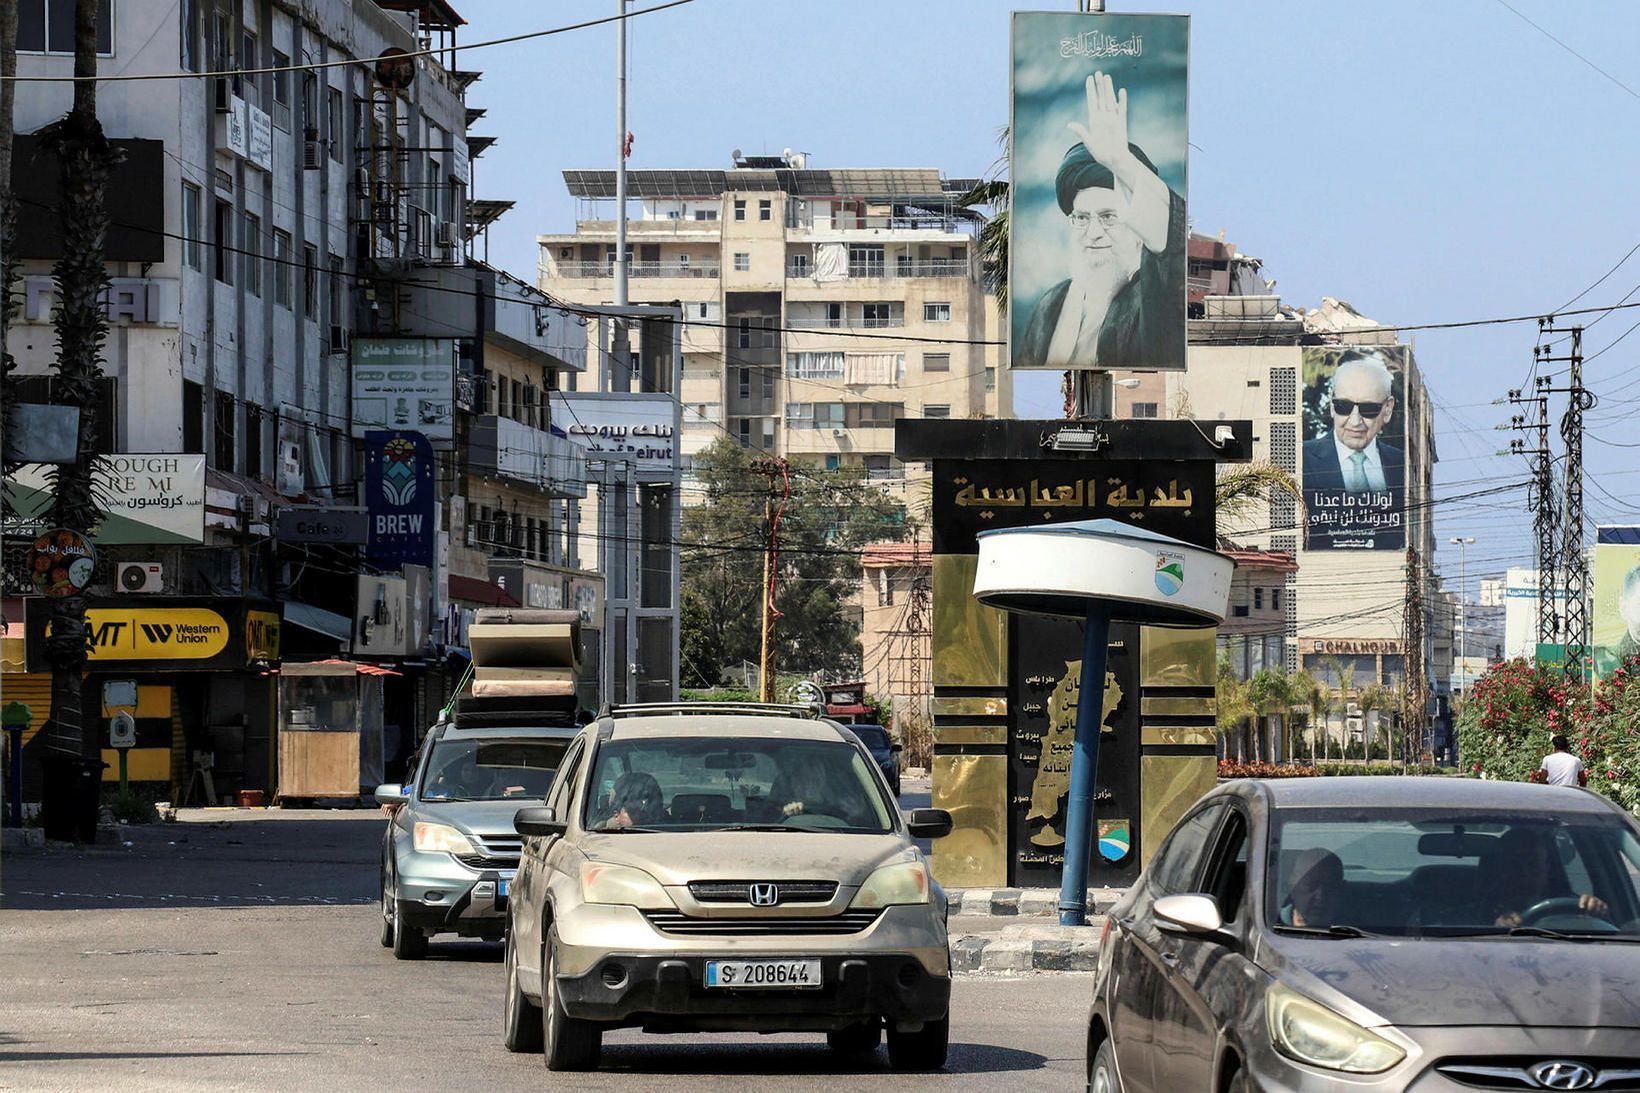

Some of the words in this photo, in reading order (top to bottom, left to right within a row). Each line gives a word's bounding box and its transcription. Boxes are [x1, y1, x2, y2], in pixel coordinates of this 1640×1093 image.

[568, 423, 628, 442] بيروت
[631, 424, 673, 443] بنك
[109, 476, 136, 494] RE
[147, 476, 173, 494] MI
[953, 477, 1096, 520] العباسية
[1106, 477, 1193, 520] بلدية
[1314, 492, 1340, 507] عدنا
[1342, 492, 1355, 507] ما
[1358, 491, 1393, 510] لولاك
[376, 514, 423, 534] BREW
[1340, 509, 1353, 527] لن
[1356, 509, 1400, 527] وبدونك
[176, 623, 220, 634] Western
[176, 633, 208, 643] Union
[1015, 730, 1040, 743] بيروت
[1019, 752, 1038, 763] صيدا
[722, 965, 733, 983] S
[744, 965, 809, 984] 208644
